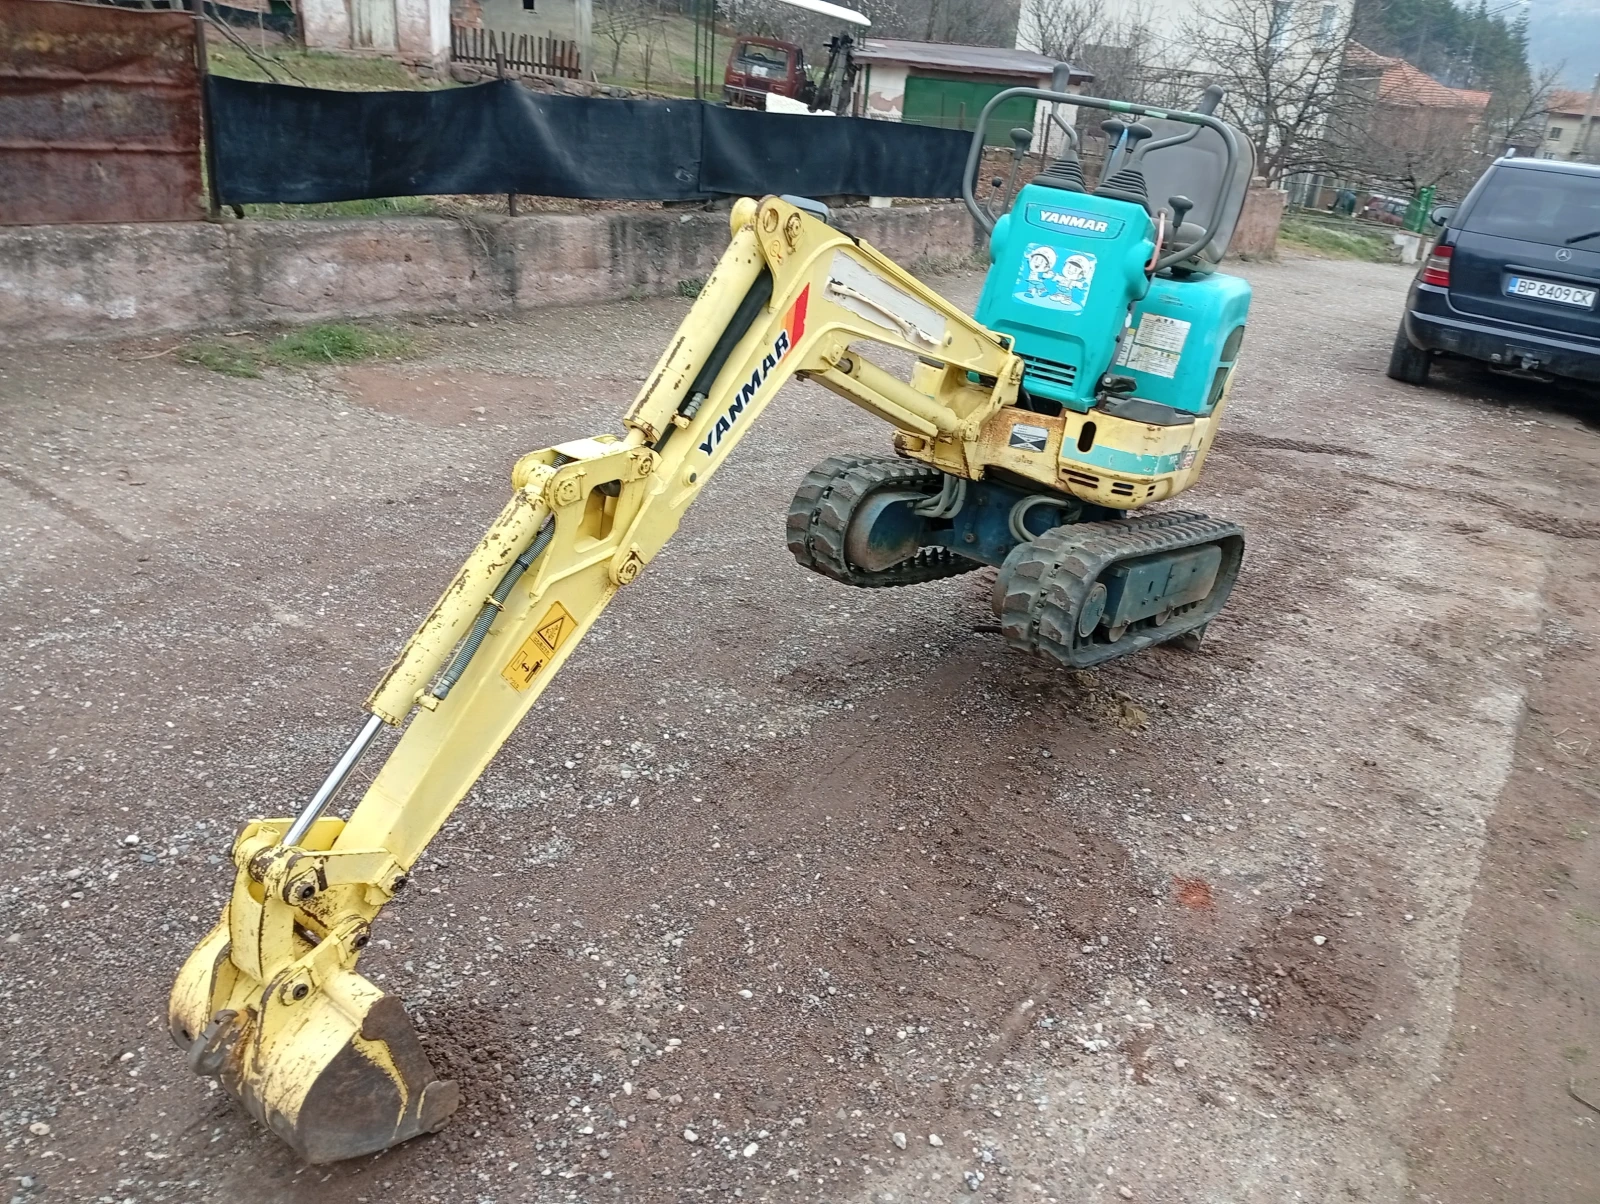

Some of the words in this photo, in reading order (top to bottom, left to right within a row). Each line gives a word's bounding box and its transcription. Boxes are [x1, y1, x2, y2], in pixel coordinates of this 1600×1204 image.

[1040, 210, 1108, 233] YANMAR
[1517, 281, 1537, 294] BP
[1537, 284, 1572, 301] 8409
[1572, 290, 1592, 305] CK
[698, 330, 789, 457] YANMAR
